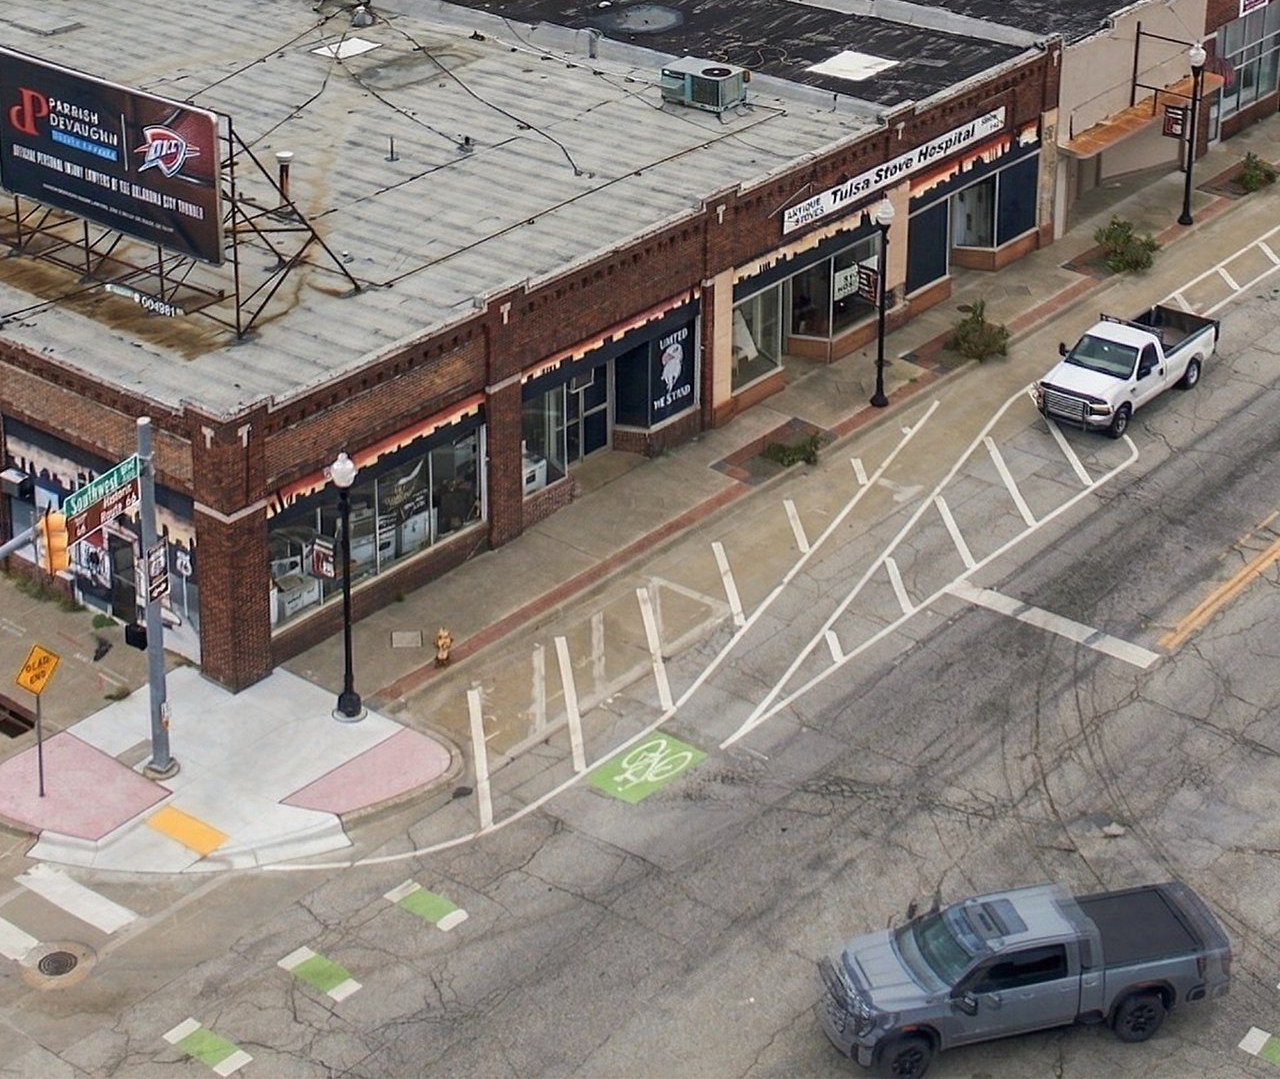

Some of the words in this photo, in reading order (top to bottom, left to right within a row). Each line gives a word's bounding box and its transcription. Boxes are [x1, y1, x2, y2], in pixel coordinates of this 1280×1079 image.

[48, 98, 98, 125] PARRISH
[50, 114, 118, 146] DEVAUGHN
[831, 180, 870, 205] Tulsa
[873, 158, 914, 186] Stove
[917, 124, 976, 164] Hospital
[788, 198, 821, 220] ANTIQUE
[795, 206, 824, 226] STOVES
[660, 327, 688, 350] UNITED
[654, 396, 666, 410] WE
[666, 384, 691, 405] STAND
[70, 470, 118, 515] Southwest
[104, 484, 132, 508] Historic
[100, 502, 122, 523] Route
[126, 492, 137, 506] 66
[26, 656, 50, 674] DEAD
[30, 670, 46, 684] END
